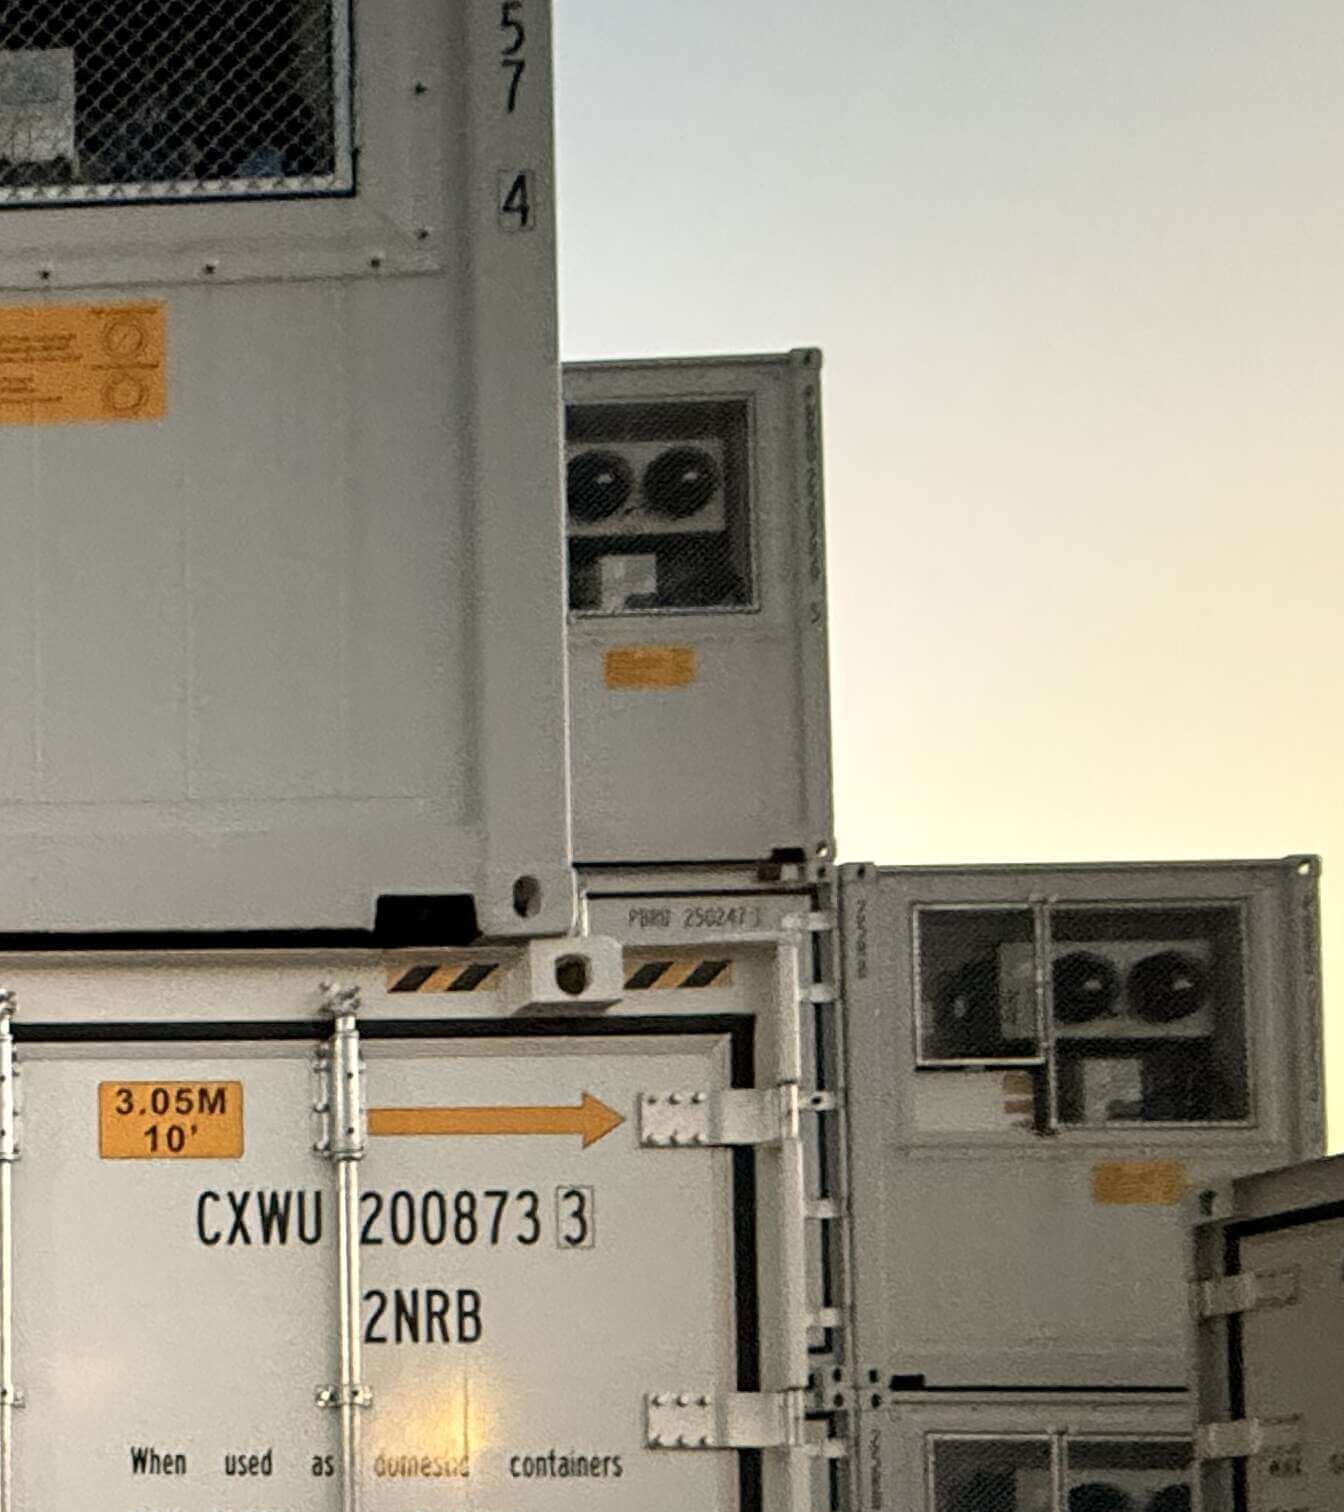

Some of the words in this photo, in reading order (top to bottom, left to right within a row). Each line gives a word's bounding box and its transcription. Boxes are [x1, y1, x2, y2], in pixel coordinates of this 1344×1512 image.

[114, 1088, 227, 1117] 3.05M
[144, 1123, 198, 1154] 10'
[197, 1190, 322, 1246] CXWU
[360, 1190, 541, 1246] 200873
[363, 1289, 482, 1344] 2NRB
[131, 1447, 186, 1475] When
[225, 1449, 272, 1476] used
[312, 1455, 335, 1477] as
[510, 1450, 623, 1478] containers
